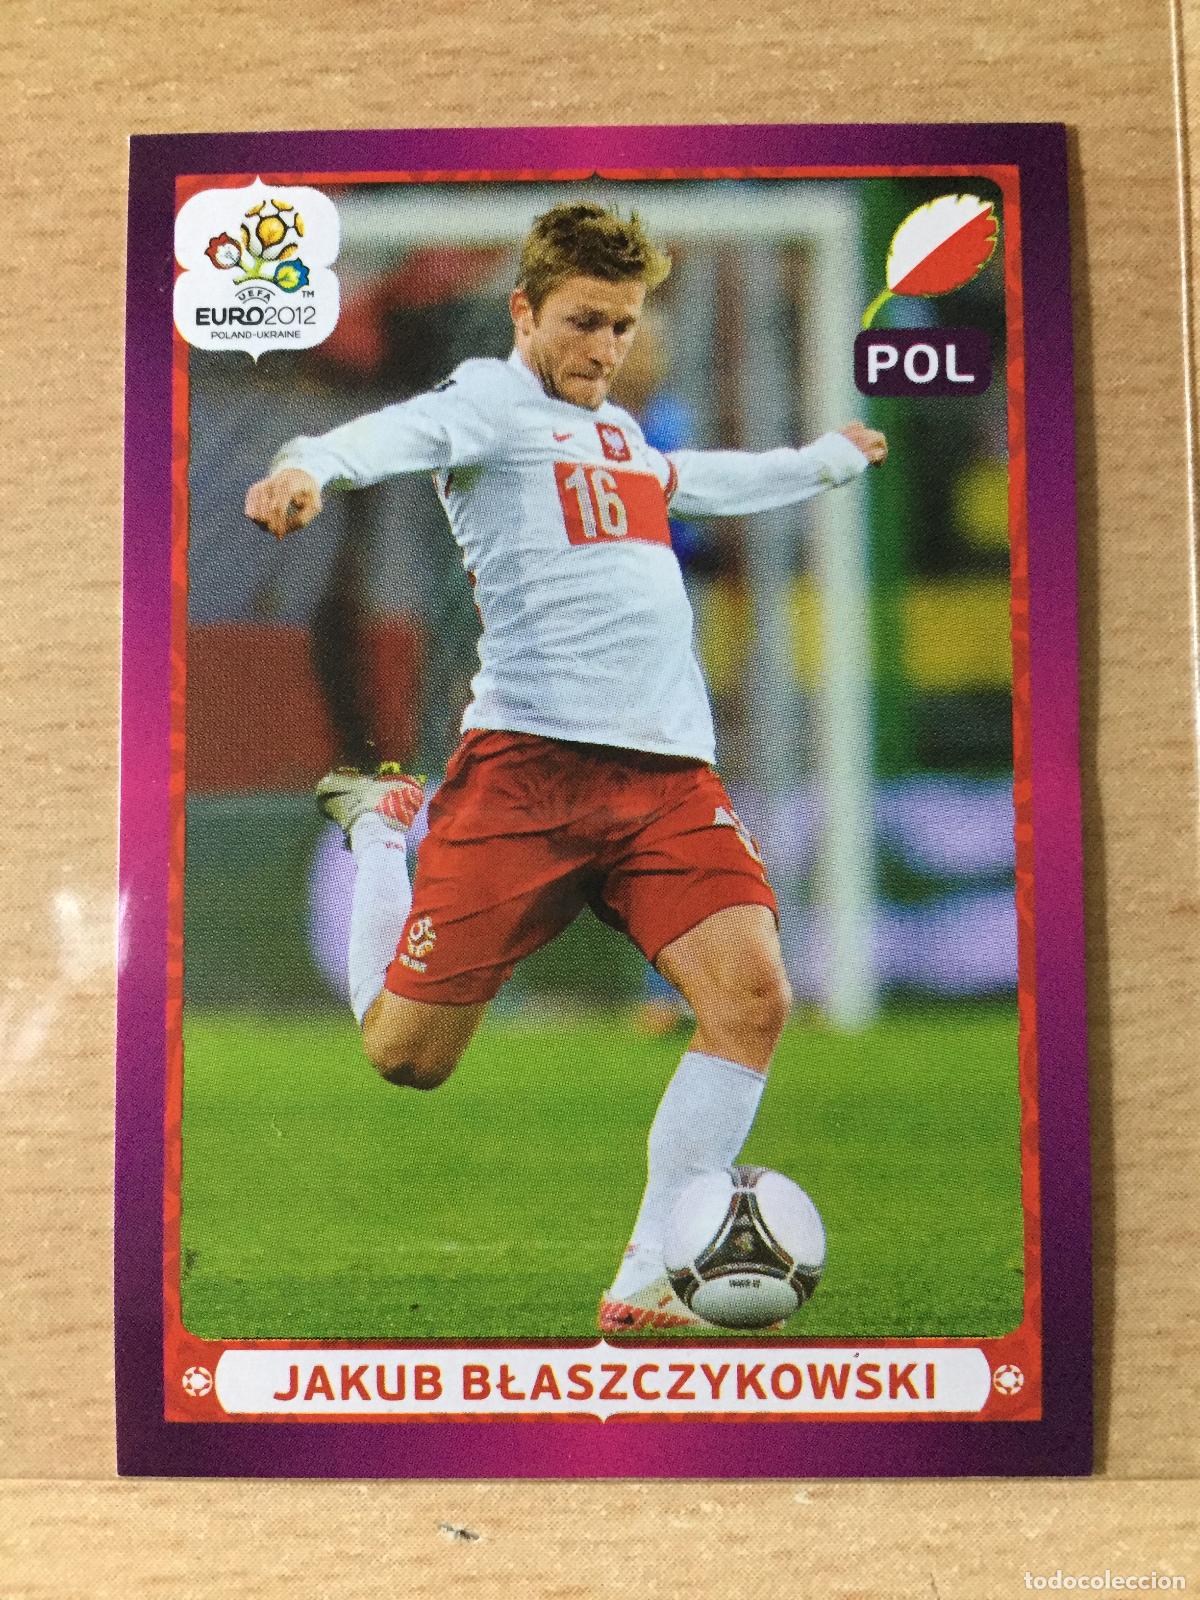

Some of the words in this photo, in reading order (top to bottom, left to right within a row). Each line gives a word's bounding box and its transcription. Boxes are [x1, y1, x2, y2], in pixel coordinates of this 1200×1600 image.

[238, 289, 272, 302] UEFA
[196, 306, 316, 326] EURO2012
[210, 330, 301, 340] POLAND-UKRAINE
[867, 344, 975, 384] POL
[564, 464, 629, 538] 16
[273, 1364, 443, 1401] JAKUB
[462, 1363, 936, 1401] BŁASZCZYKOWSKI
